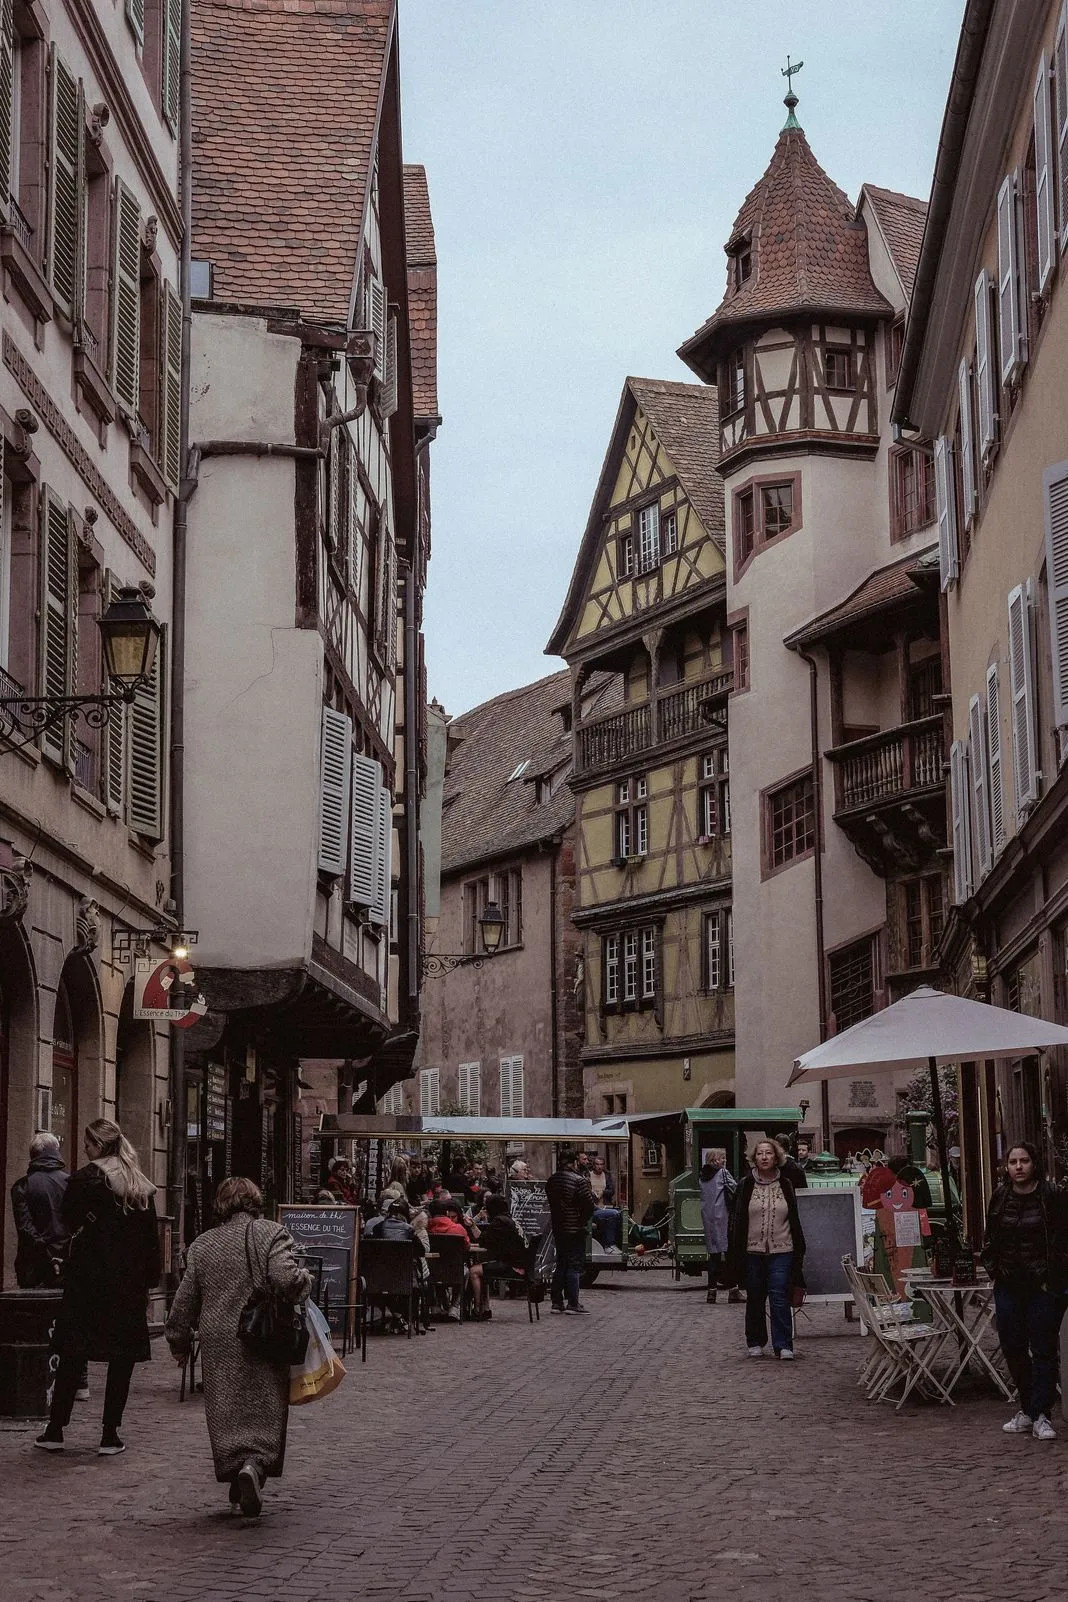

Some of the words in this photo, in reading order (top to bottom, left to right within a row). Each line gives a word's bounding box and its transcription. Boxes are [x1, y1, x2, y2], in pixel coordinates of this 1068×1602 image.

[319, 1211, 328, 1219] de
[329, 1211, 348, 1220] thé
[284, 1222, 321, 1231] L'ESSENCE
[322, 1224, 332, 1233] DU
